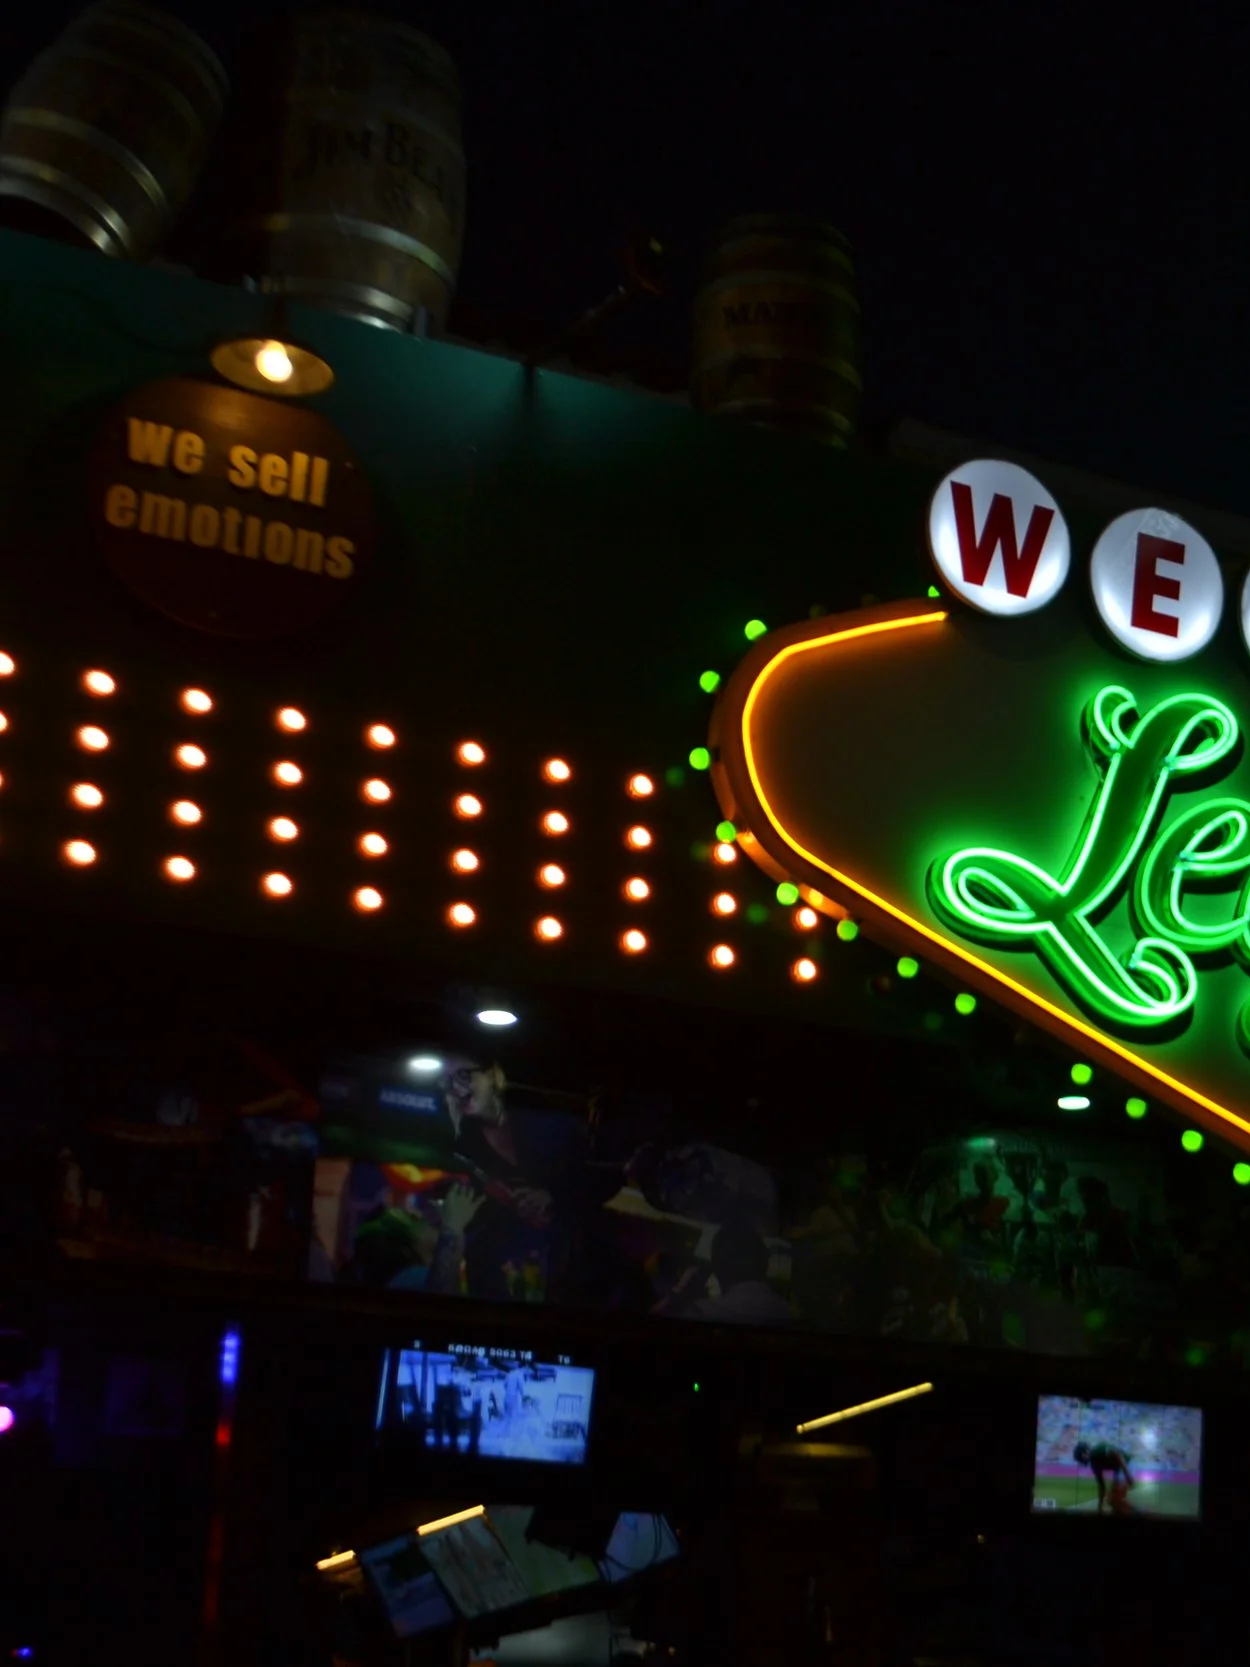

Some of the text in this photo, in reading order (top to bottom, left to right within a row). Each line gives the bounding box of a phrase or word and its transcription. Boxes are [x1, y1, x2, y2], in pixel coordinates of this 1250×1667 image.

[127, 416, 330, 508] we sell
[103, 483, 357, 580] emotions
